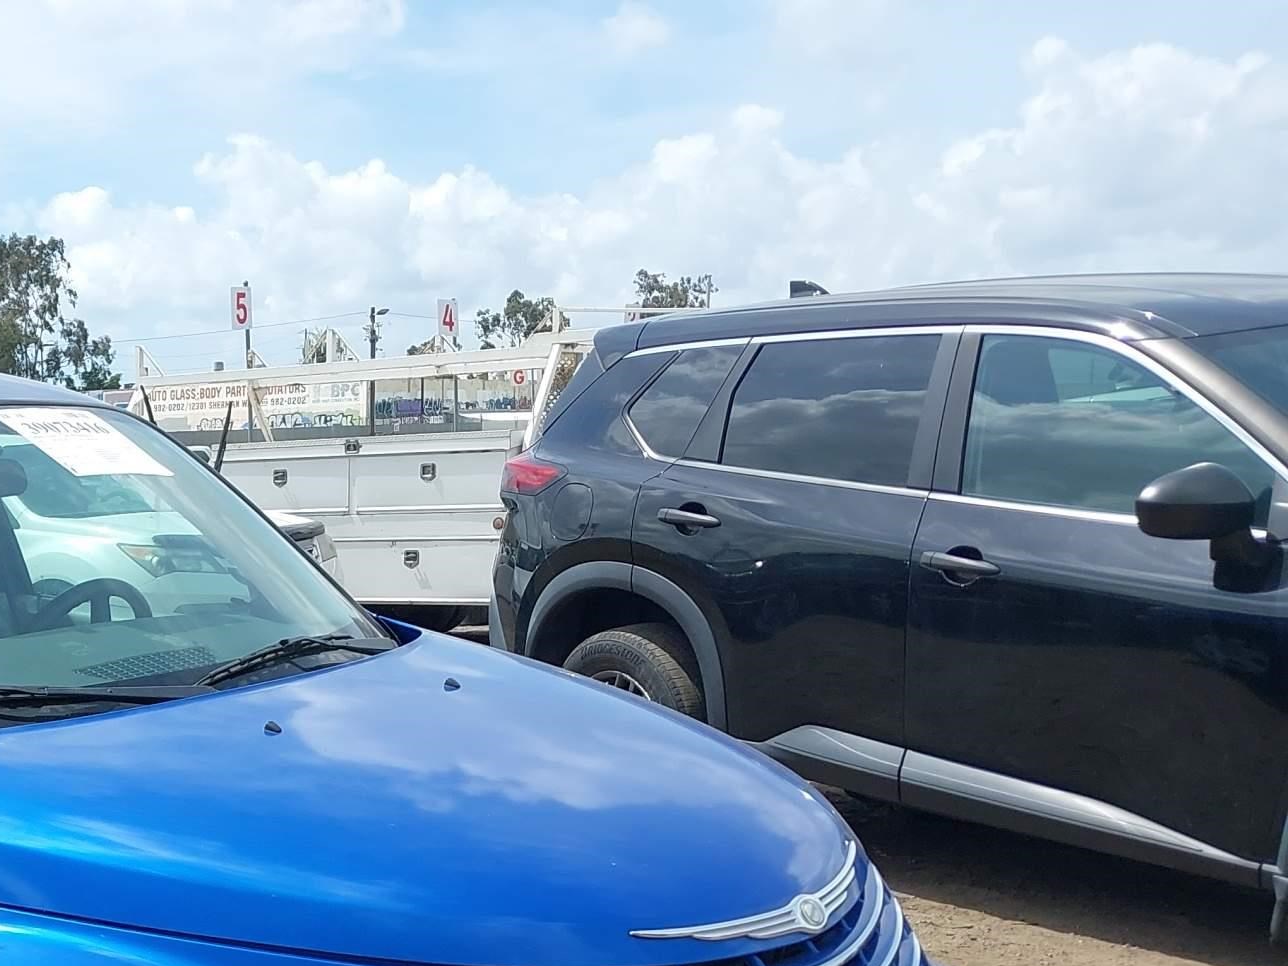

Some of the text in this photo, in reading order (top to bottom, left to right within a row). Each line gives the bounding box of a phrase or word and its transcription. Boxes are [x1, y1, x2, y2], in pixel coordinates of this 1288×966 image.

[236, 292, 248, 325] 5
[442, 303, 455, 332] 4
[513, 369, 525, 385] G
[20, 421, 110, 435] 39073416
